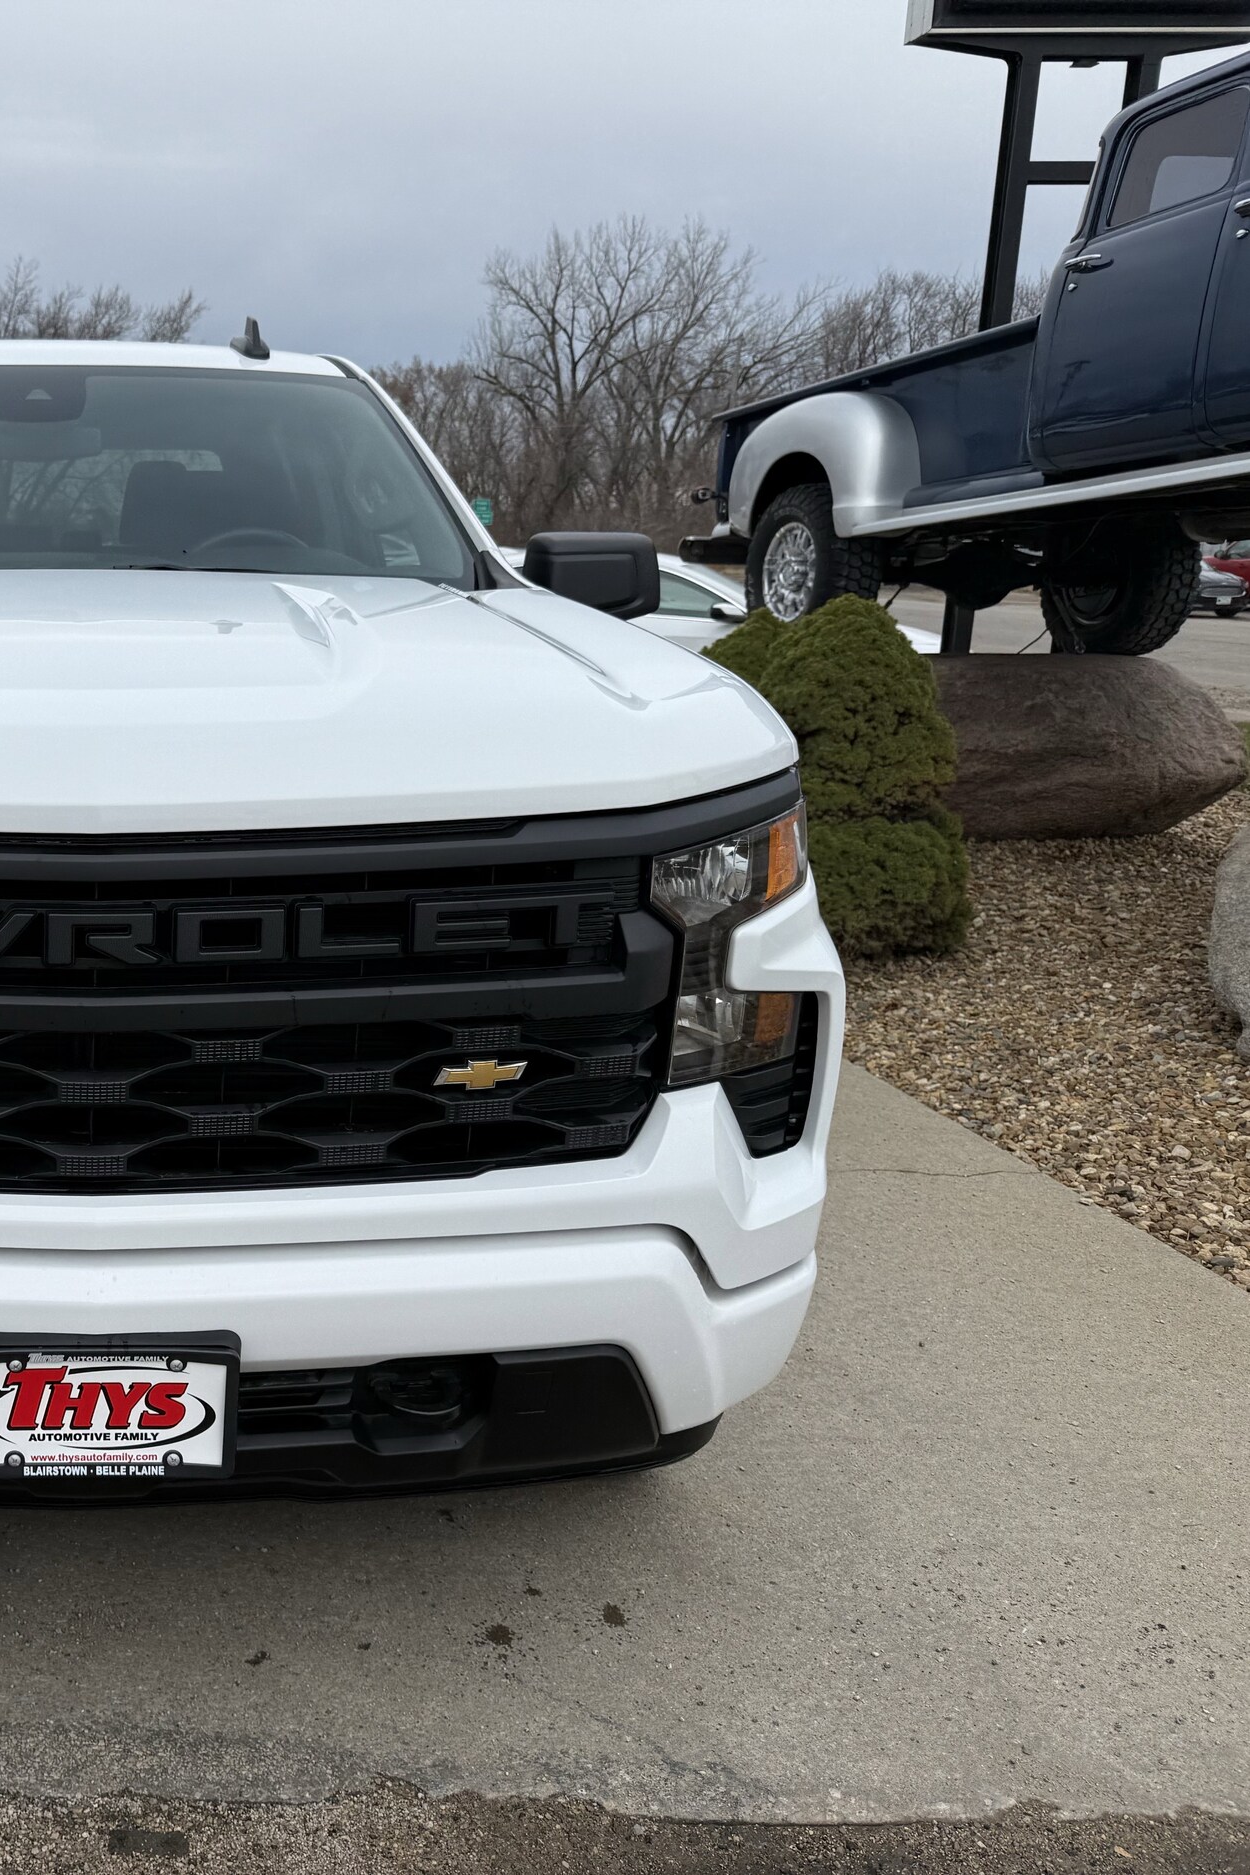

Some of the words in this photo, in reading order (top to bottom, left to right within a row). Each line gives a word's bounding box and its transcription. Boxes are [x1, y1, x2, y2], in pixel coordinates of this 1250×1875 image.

[67, 1355, 132, 1363] AUTOMOTIVE
[134, 1355, 169, 1363] FAMILY
[3, 1366, 189, 1430] THYS
[29, 1432, 111, 1442] AUTOMOTIVE
[114, 1431, 159, 1441] FAMILY
[30, 1452, 158, 1463] www.thysautofamily.com
[23, 1465, 88, 1477] BLAIRSTOWN
[95, 1465, 127, 1476] BELLE
[129, 1465, 165, 1476] PLAINE
